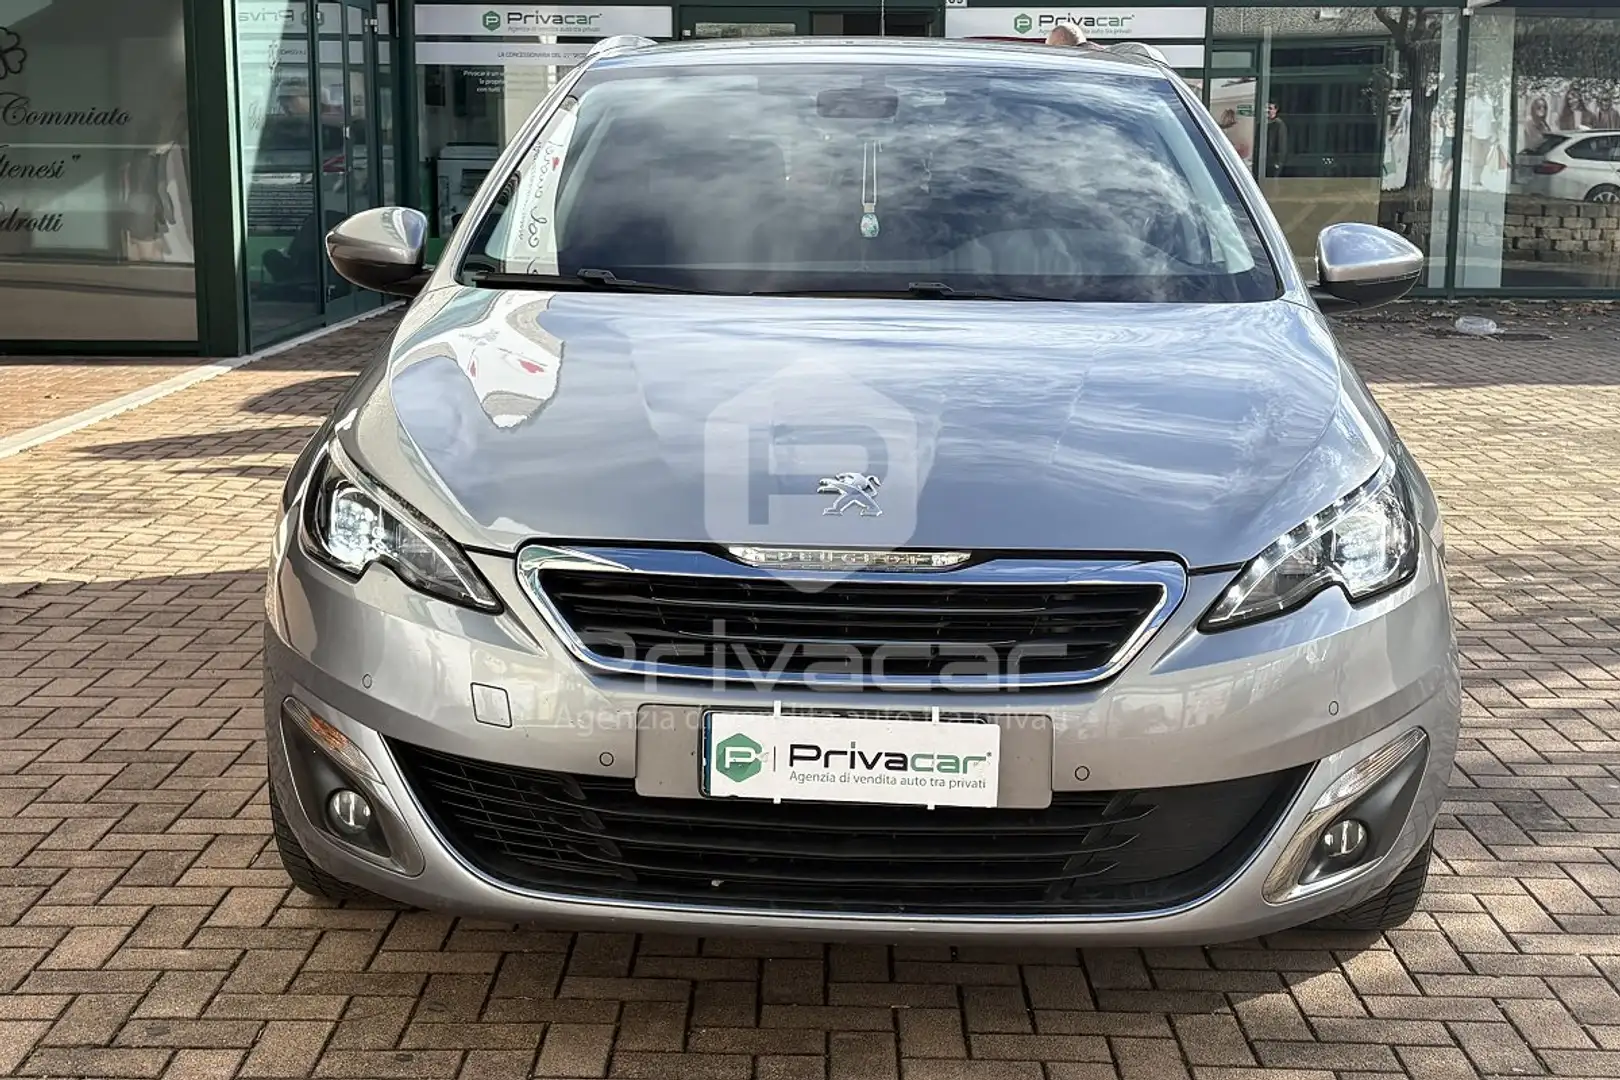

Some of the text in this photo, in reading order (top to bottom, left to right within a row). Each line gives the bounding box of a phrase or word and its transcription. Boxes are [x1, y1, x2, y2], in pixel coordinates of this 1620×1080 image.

[507, 10, 600, 24] Privacar
[1039, 13, 1132, 26] Privacar
[2, 96, 131, 126] Commiato
[789, 741, 987, 774] Privacar
[789, 770, 987, 789] Agenzia di vendita auto tra privati
